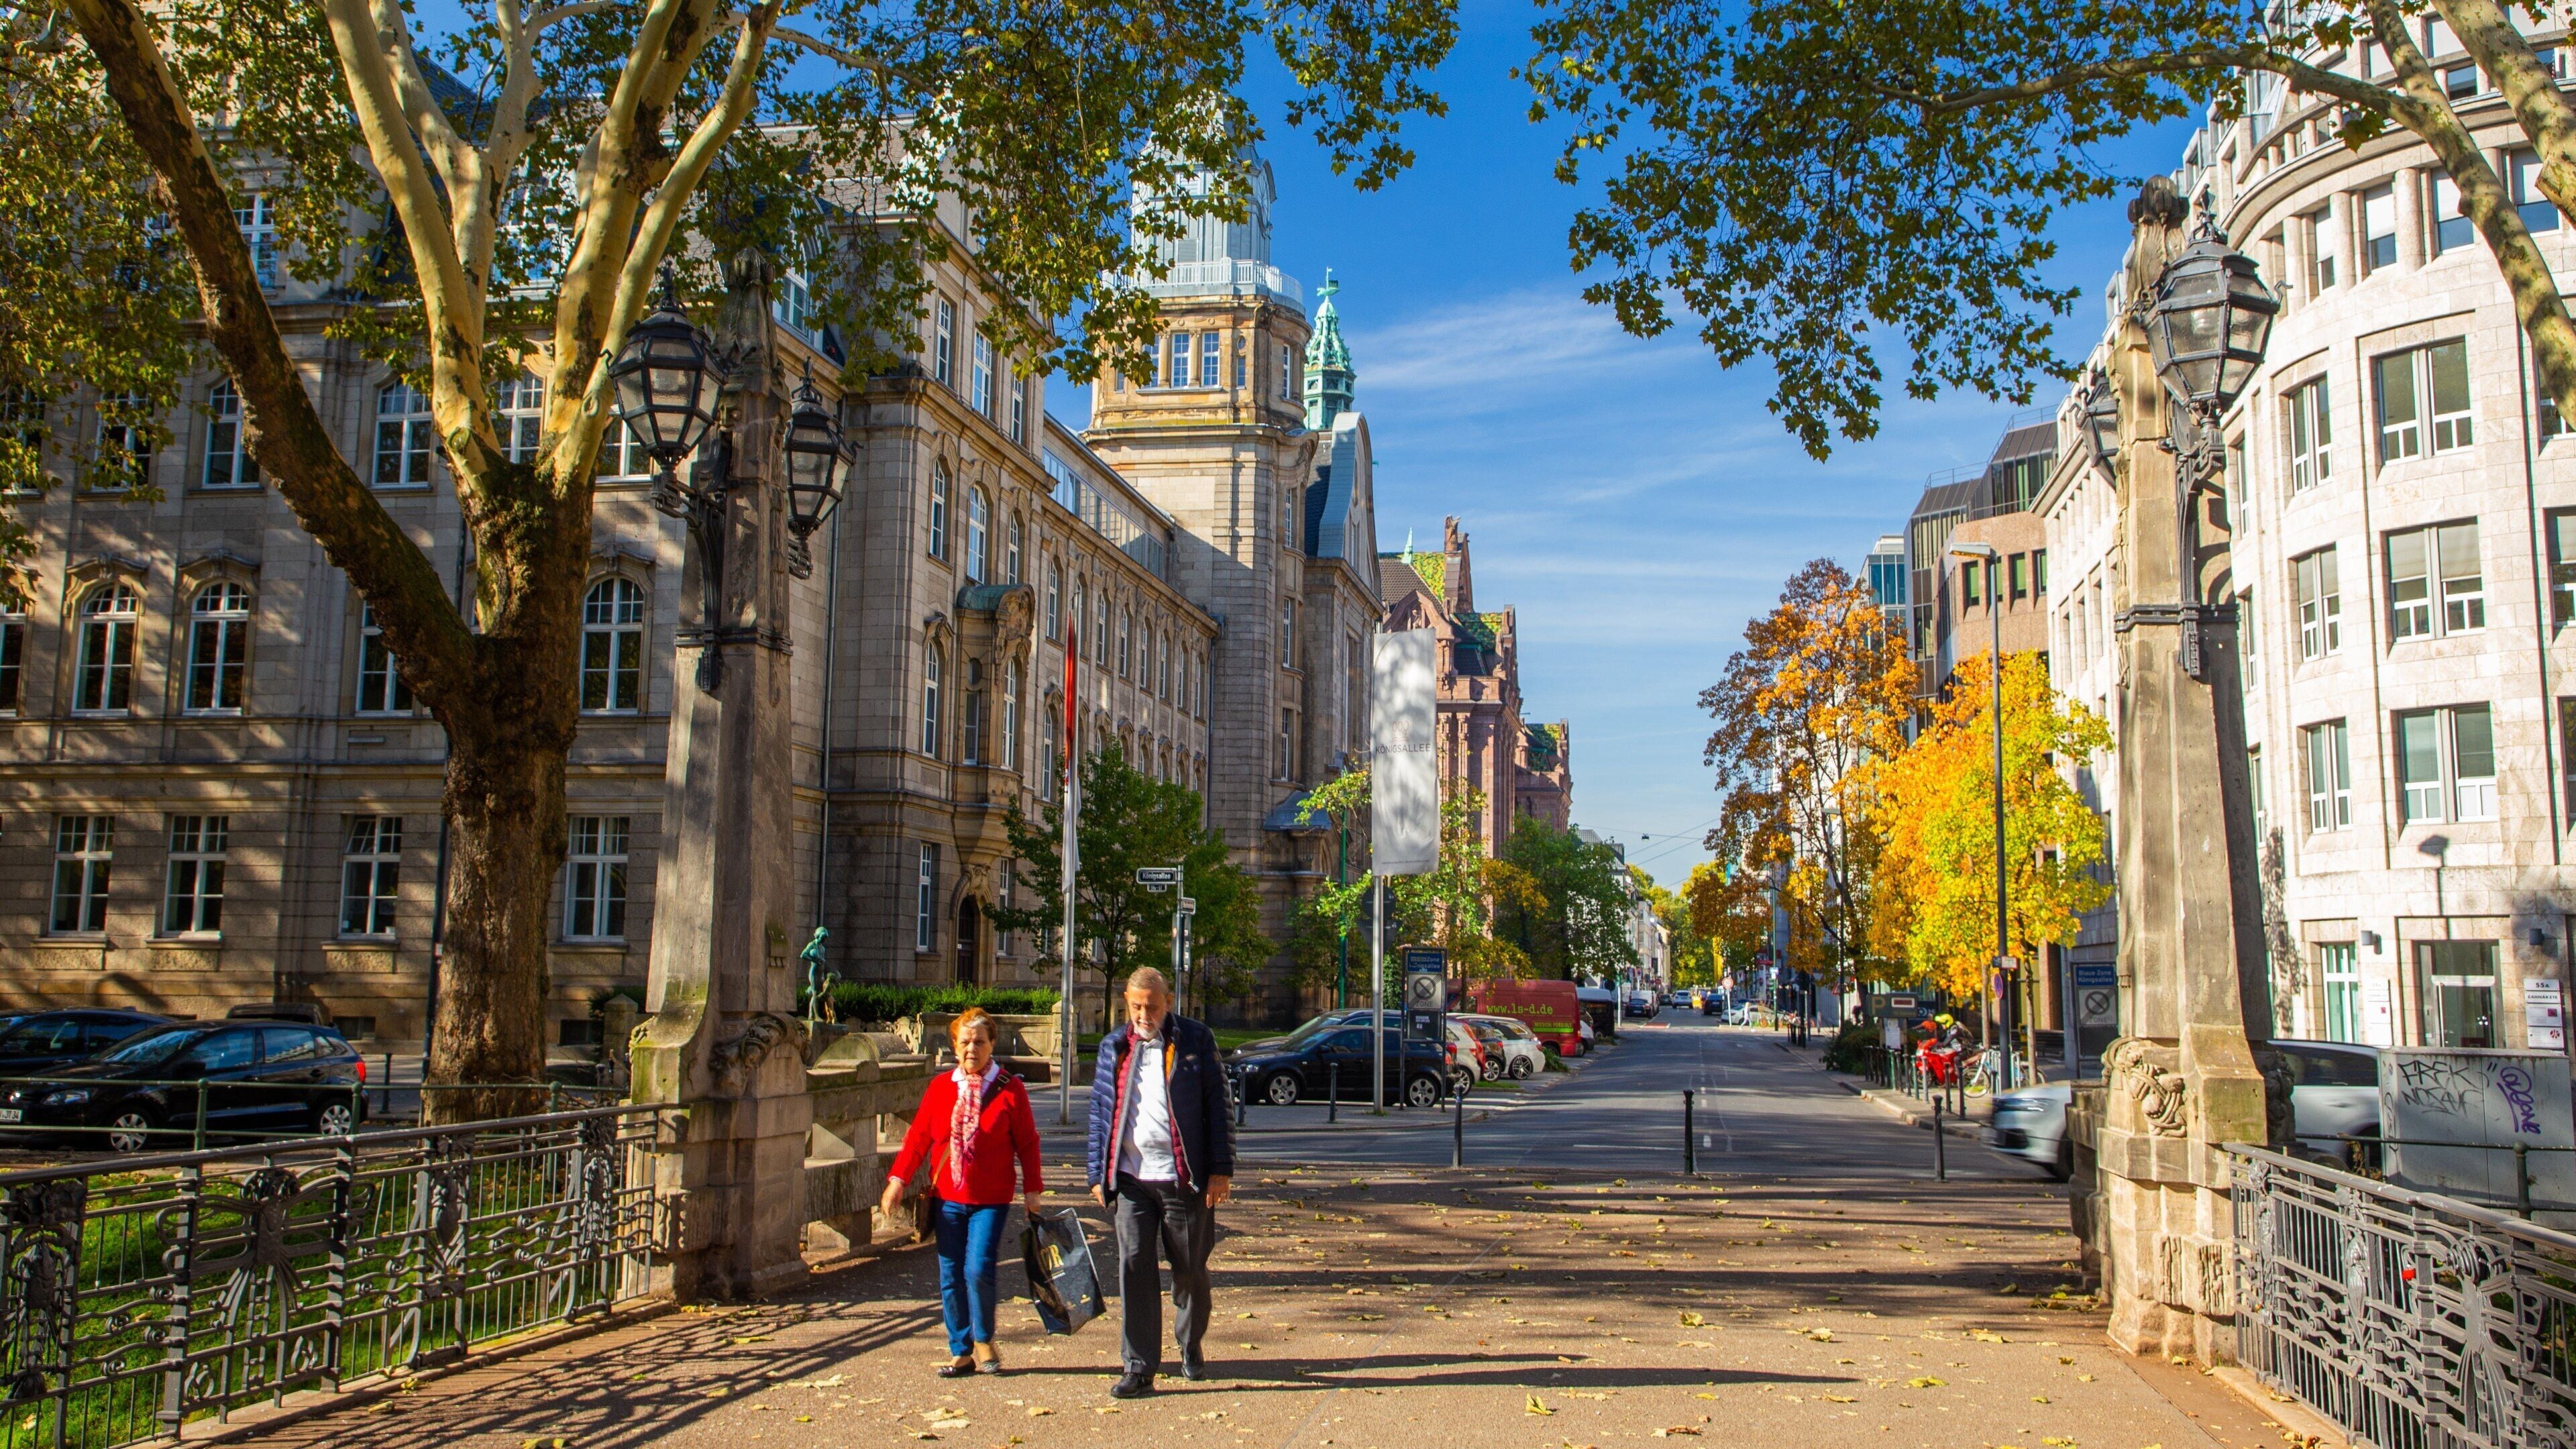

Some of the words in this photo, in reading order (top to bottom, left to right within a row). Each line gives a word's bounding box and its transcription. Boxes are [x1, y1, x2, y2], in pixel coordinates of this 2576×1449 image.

[1376, 743, 1431, 754] KÖNIGSALLEE
[1142, 872, 1171, 880] Königsallee
[1487, 1004, 1553, 1014] www.ls-d.de
[1872, 997, 1886, 1014] P
